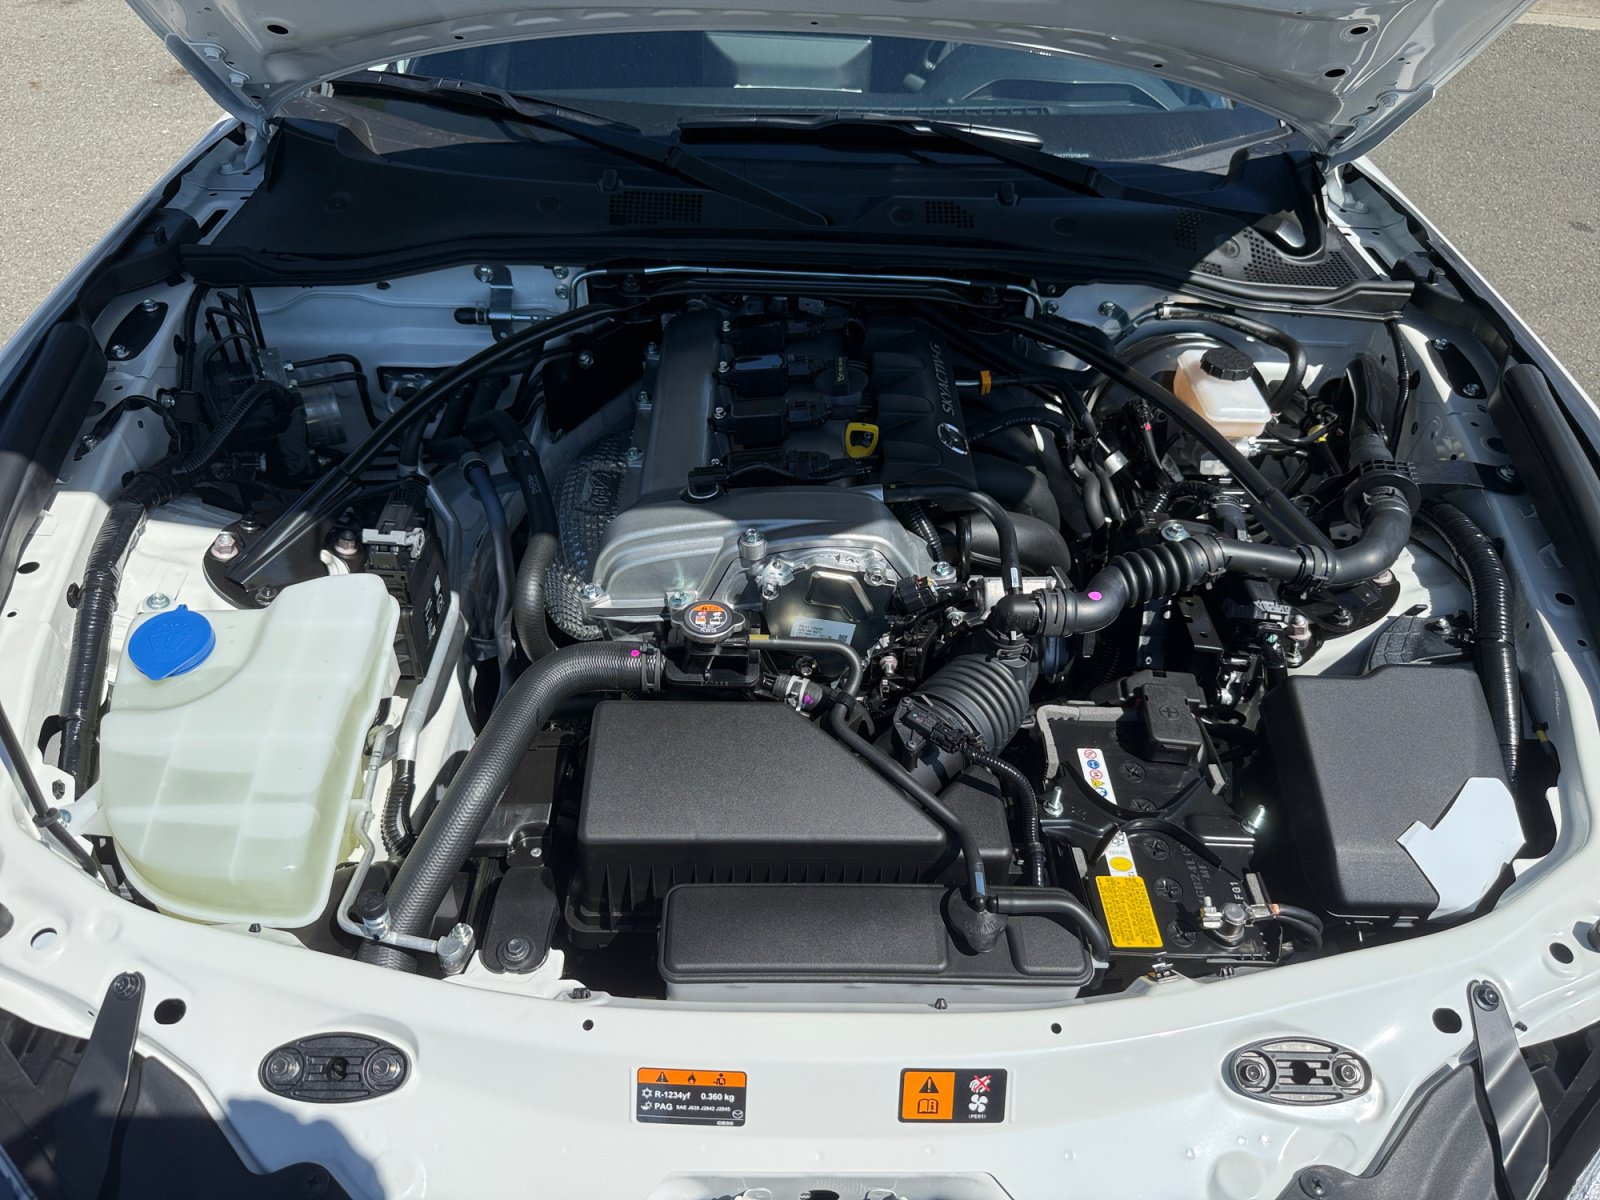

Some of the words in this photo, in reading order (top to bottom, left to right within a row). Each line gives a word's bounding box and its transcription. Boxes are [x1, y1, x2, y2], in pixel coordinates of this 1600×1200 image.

[929, 341, 955, 416] SKYACTIV-G
[654, 1090, 691, 1101] R-1234yf
[700, 1092, 723, 1101] 0.360
[724, 1093, 735, 1103] kg
[654, 1103, 673, 1111] PAG
